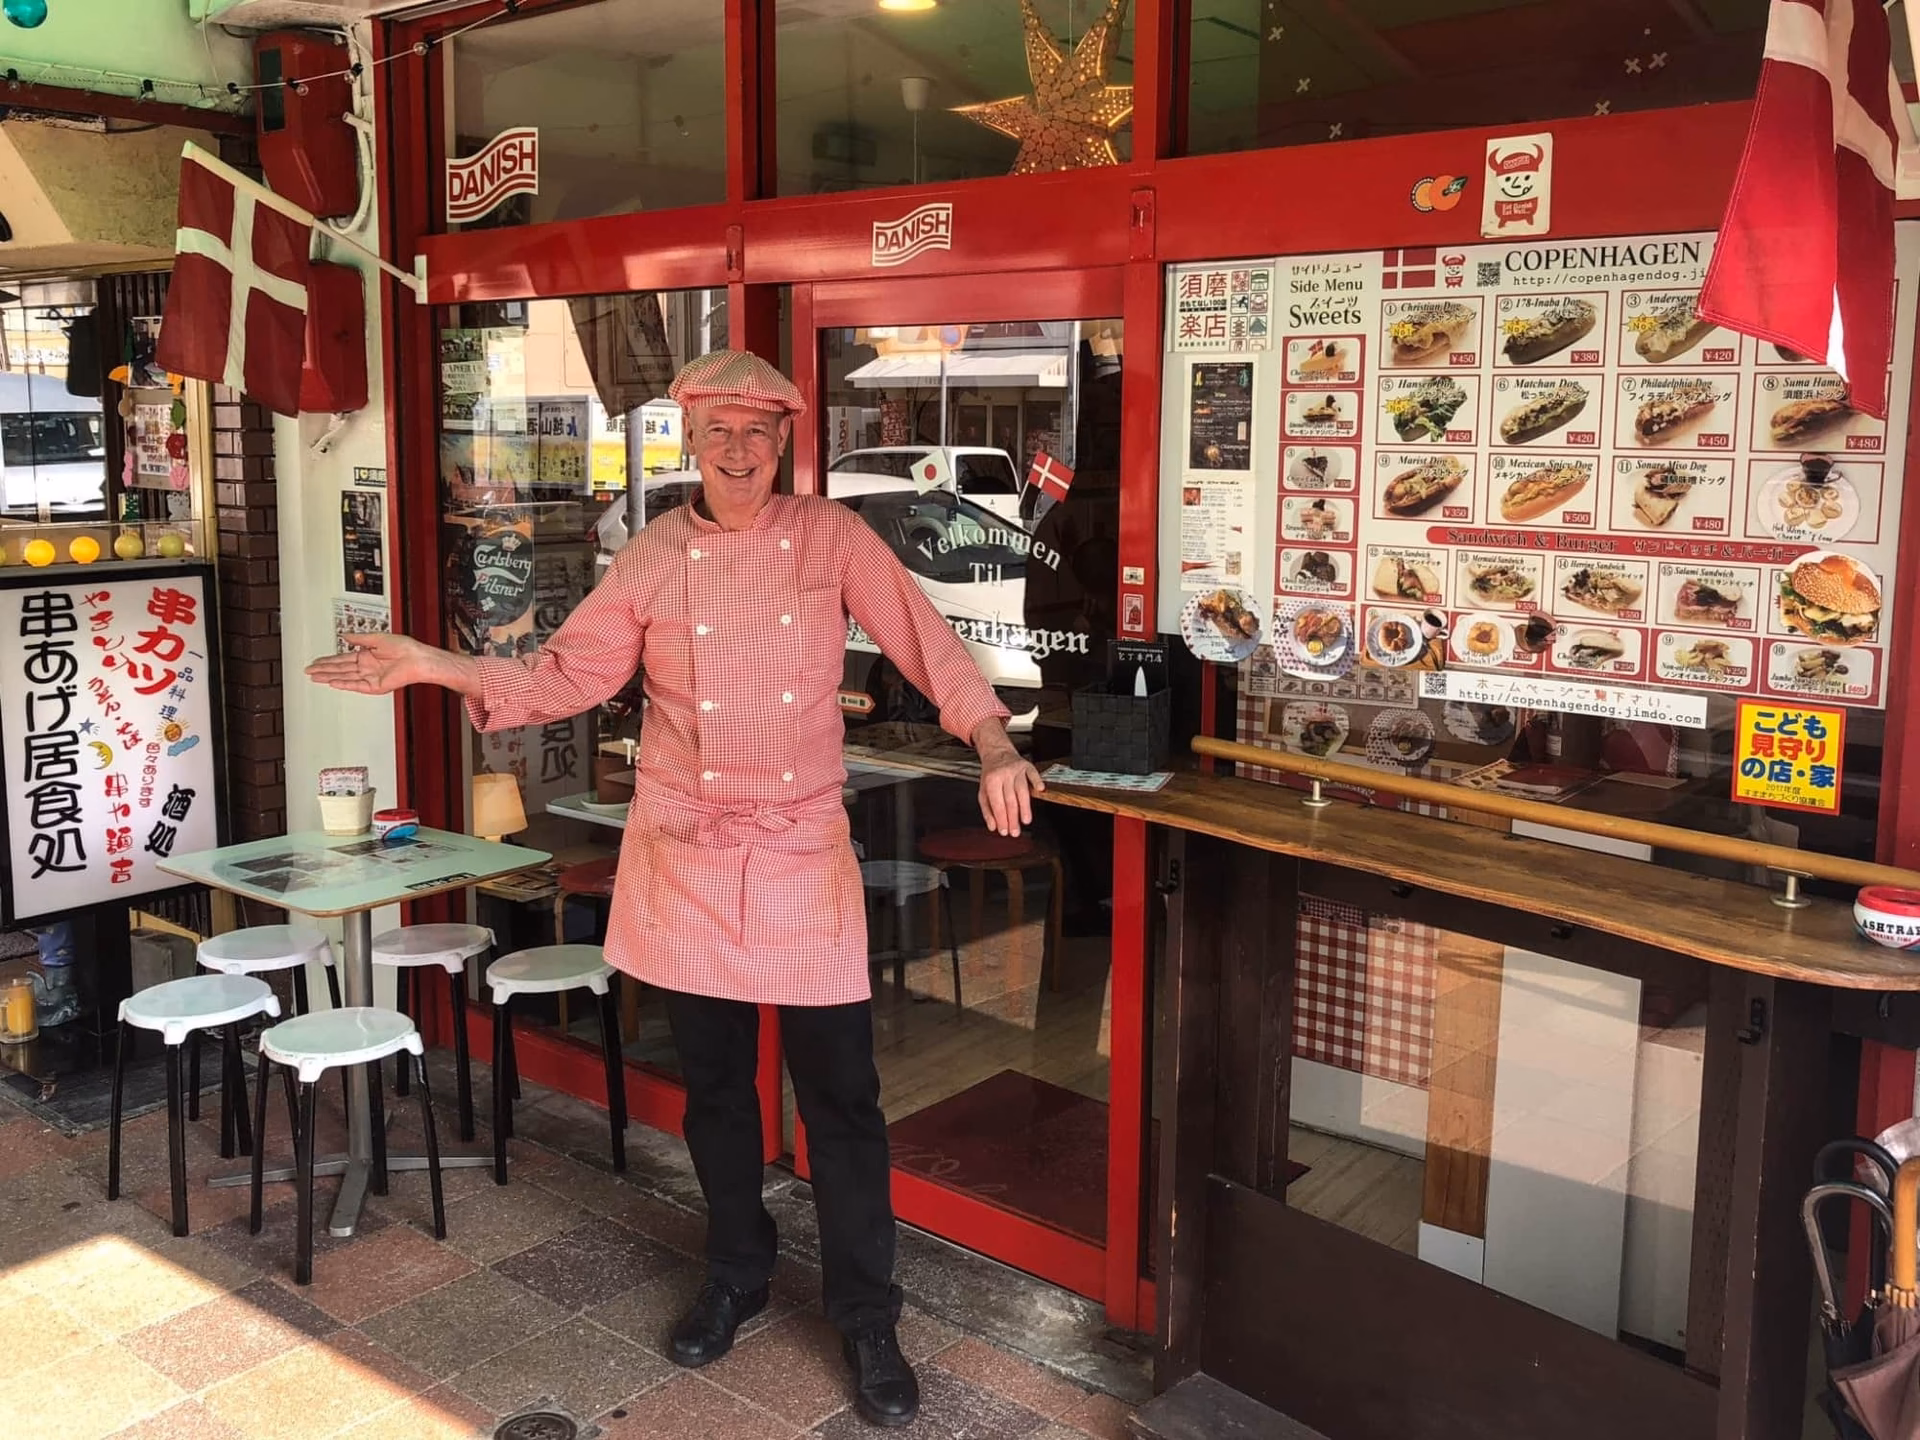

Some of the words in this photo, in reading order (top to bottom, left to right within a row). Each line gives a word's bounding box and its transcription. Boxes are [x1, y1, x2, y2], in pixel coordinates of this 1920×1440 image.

[449, 140, 536, 202] DANISH
[875, 212, 950, 251] DANISH
[1505, 241, 1700, 272] COPENHAGEN
[1179, 272, 1227, 298] 須磨
[1290, 280, 1319, 293] Side
[1325, 279, 1363, 292] Menu
[1179, 314, 1227, 339] 楽店
[1289, 304, 1361, 328] Sweets
[1451, 354, 1474, 363] ¥450
[1573, 352, 1598, 361] ¥380
[1705, 351, 1732, 360] ¥420
[1514, 378, 1556, 388] Matchan
[1640, 378, 1693, 390] Philadelphia
[1783, 377, 1810, 388] Suma
[1447, 432, 1471, 441] ¥450
[1568, 434, 1594, 443] ¥420
[1699, 437, 1727, 446] ¥450
[1848, 439, 1878, 449] ¥480
[1398, 456, 1428, 465] Marist
[1508, 458, 1546, 468] Mexican
[1574, 460, 1593, 471] Dog
[1667, 460, 1688, 471] Miso
[1690, 461, 1708, 473] Dog
[1564, 513, 1590, 523] ¥500
[1694, 520, 1722, 530] ¥480
[917, 525, 1061, 571] Velkommen
[1448, 527, 1528, 548] Sandwich
[1533, 532, 1549, 548] &
[1555, 533, 1618, 553] Burger
[473, 544, 531, 573] Carlsberg
[472, 571, 525, 597] Pilsner
[969, 562, 1003, 587] Til
[1674, 566, 1699, 576] Salami
[1700, 568, 1735, 578] Sandwich
[79, 590, 130, 673] やきとり
[131, 586, 197, 696] 串カツ
[158, 650, 205, 723] 一品料理
[1458, 688, 1702, 725] http://copenhagendog.jimdo.com
[20, 590, 87, 880] 串あげ居食処
[1754, 711, 1827, 740] こども
[1750, 733, 1826, 763] 見守り
[138, 741, 161, 809] 色々あります
[1740, 757, 1835, 788] の店・家
[144, 783, 196, 859] 酒処
